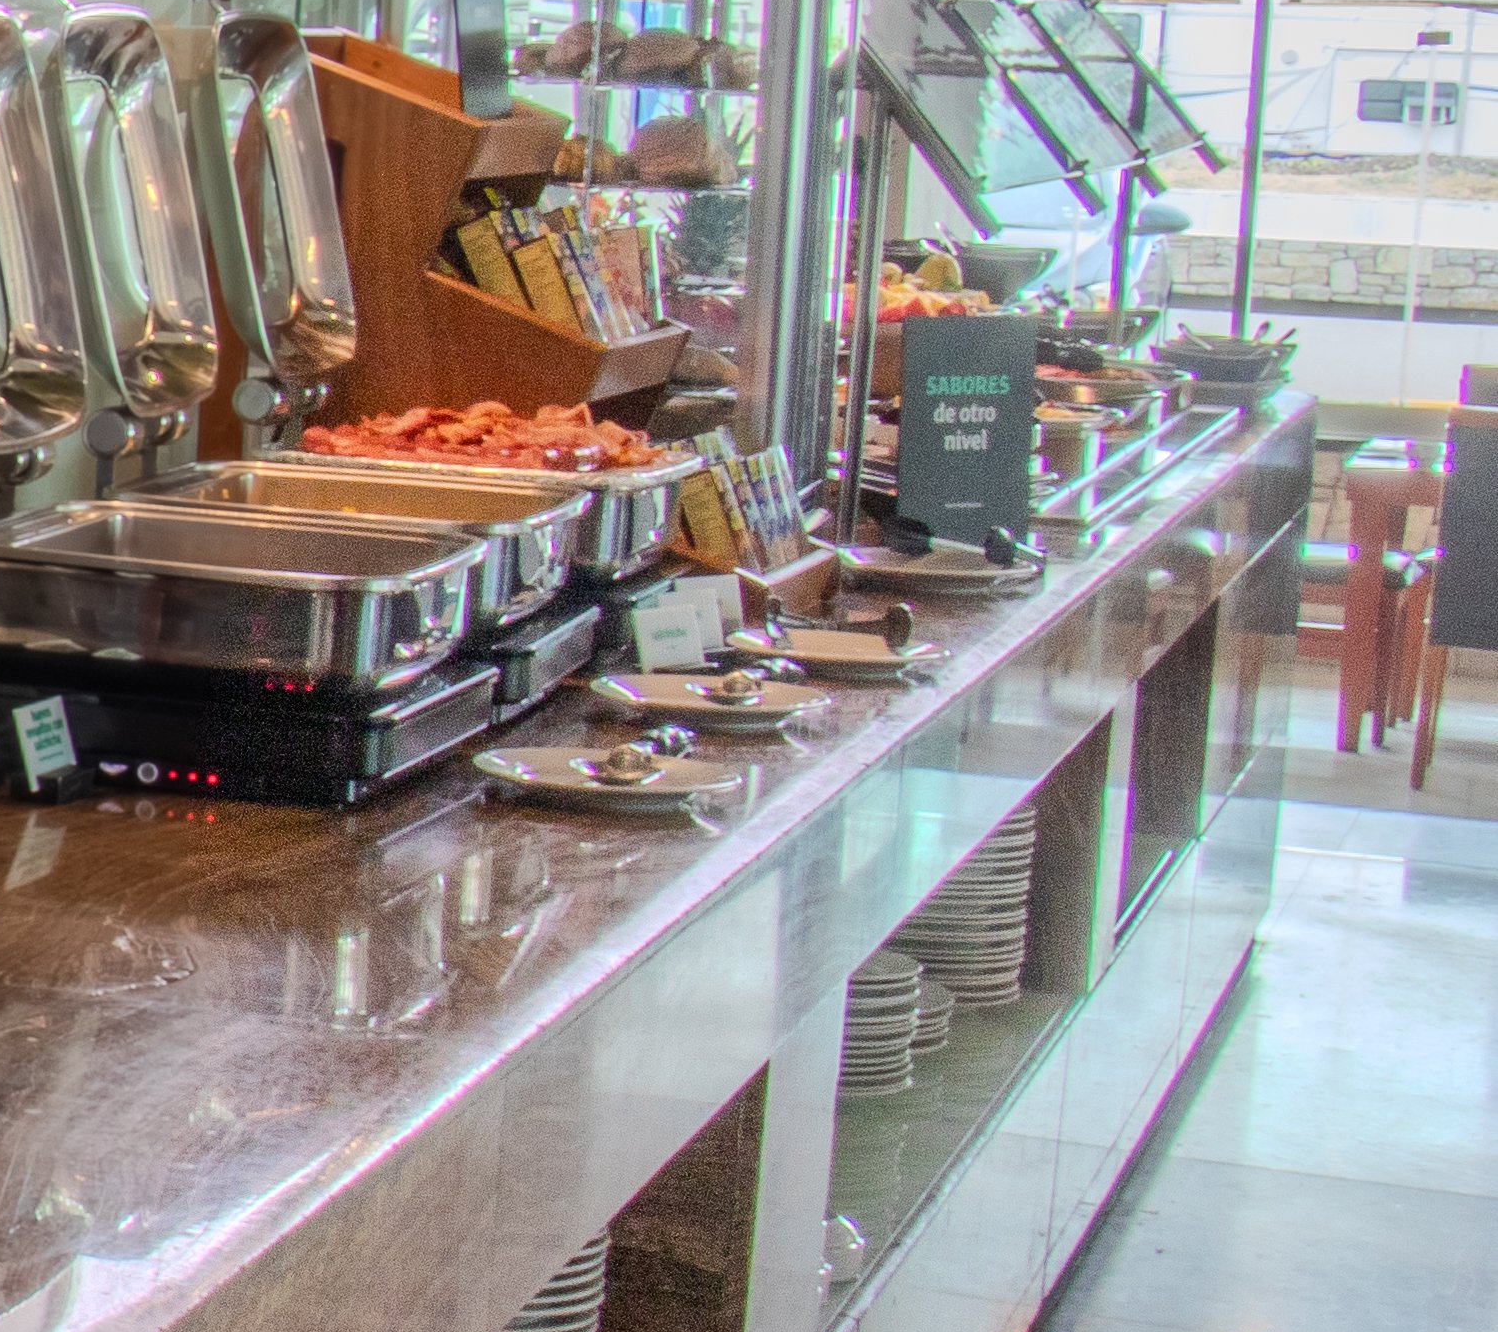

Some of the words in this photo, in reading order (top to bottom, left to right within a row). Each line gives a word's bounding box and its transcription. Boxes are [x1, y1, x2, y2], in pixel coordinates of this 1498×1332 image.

[926, 375, 1010, 396] SABORES
[933, 402, 957, 424] de
[959, 403, 998, 423] otro
[944, 428, 989, 451] nivel
